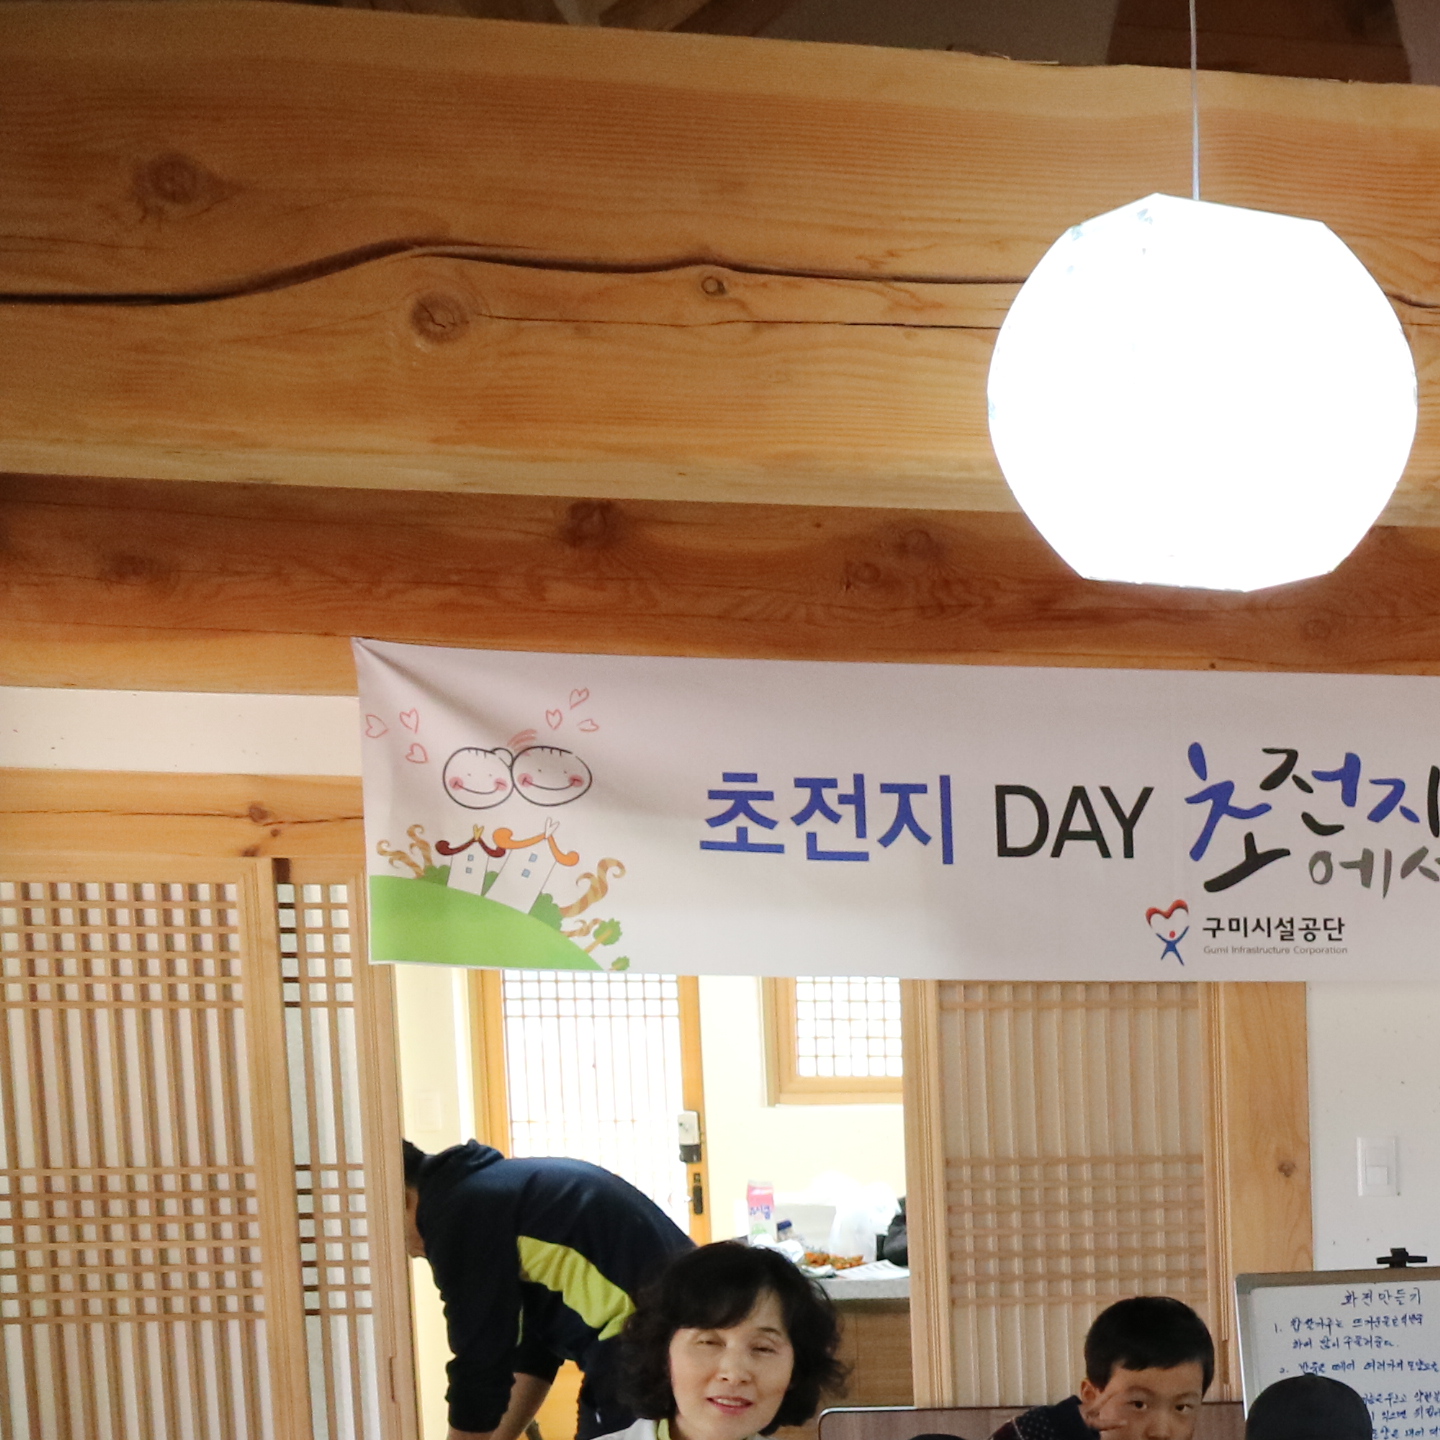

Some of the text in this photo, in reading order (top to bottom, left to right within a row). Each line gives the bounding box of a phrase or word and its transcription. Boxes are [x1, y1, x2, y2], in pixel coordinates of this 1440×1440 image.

[699, 771, 955, 866] 초전지
[994, 784, 1155, 860] DAY
[1202, 916, 1346, 943] 구미시설공단
[1203, 945, 1348, 956] Gumi Infrastructure Corporation
